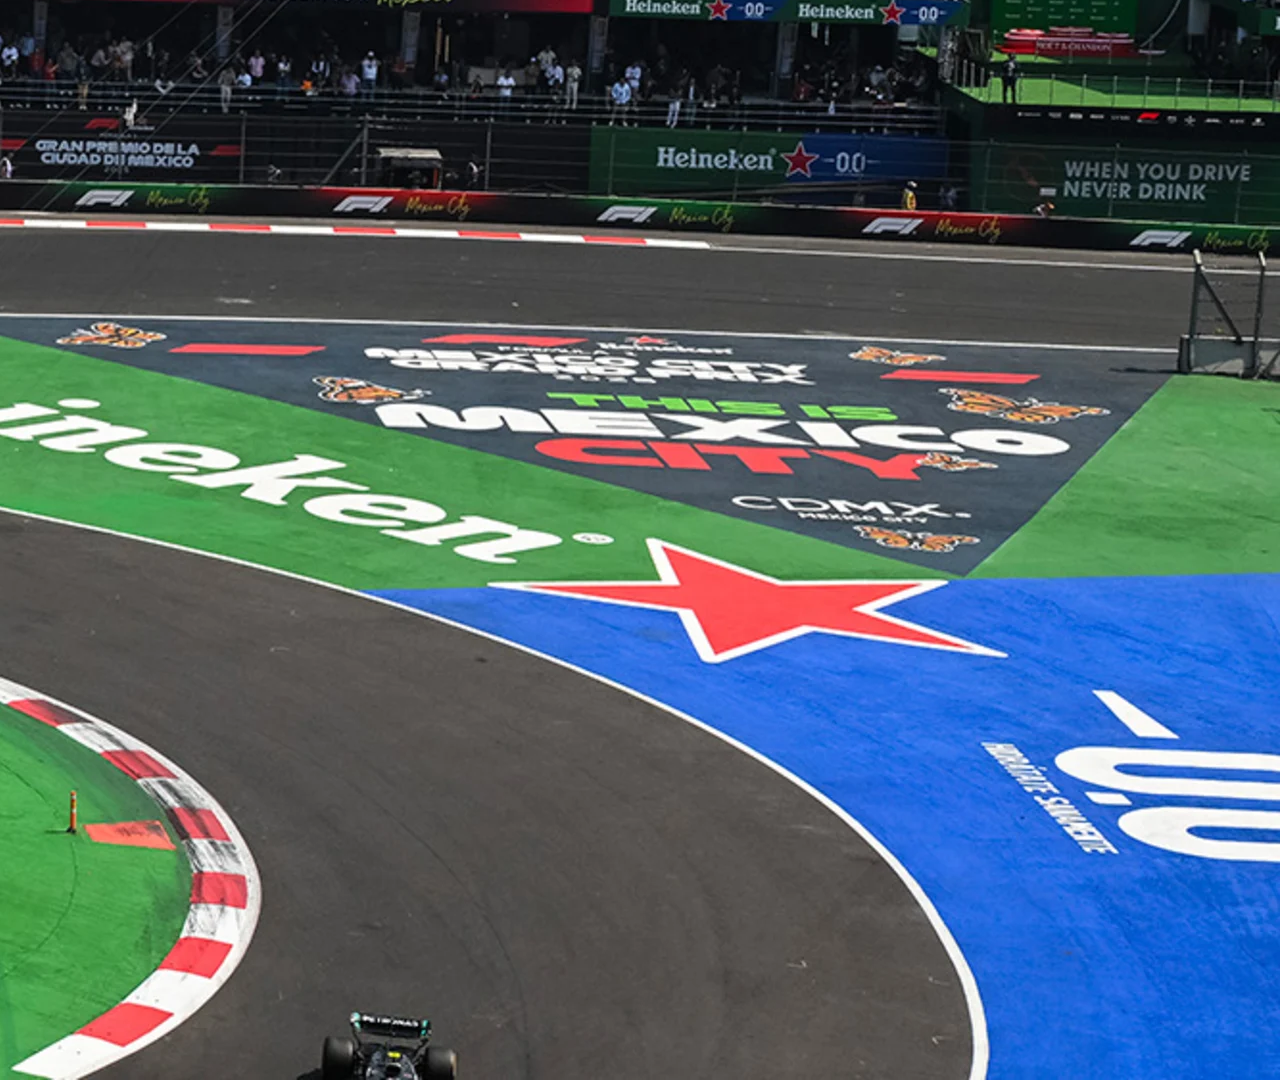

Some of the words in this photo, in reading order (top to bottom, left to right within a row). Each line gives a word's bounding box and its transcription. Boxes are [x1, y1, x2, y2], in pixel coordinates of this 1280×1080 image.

[798, 3, 874, 20] Heineken
[35, 140, 83, 152] GRAN
[86, 141, 149, 154] PREMIO
[153, 144, 175, 155] DE
[177, 144, 200, 156] LA
[40, 153, 100, 166] CIUDAD
[656, 146, 774, 171] Heineken
[1064, 161, 1129, 179] WHEN
[1136, 163, 1181, 180] YOU
[1189, 164, 1251, 182] DRIVE
[1063, 181, 1132, 199] NEVER
[1139, 183, 1207, 201] DRINK
[597, 341, 734, 355] Heineken
[363, 347, 639, 369] MEXICO
[640, 358, 809, 376] CITY
[390, 359, 638, 380] GRAND
[644, 366, 817, 387] PRIX
[546, 391, 787, 418] THIS
[797, 403, 899, 420] IS
[374, 403, 1071, 456] MEXICO
[534, 438, 924, 481] CITY
[732, 495, 957, 518] CDMX
